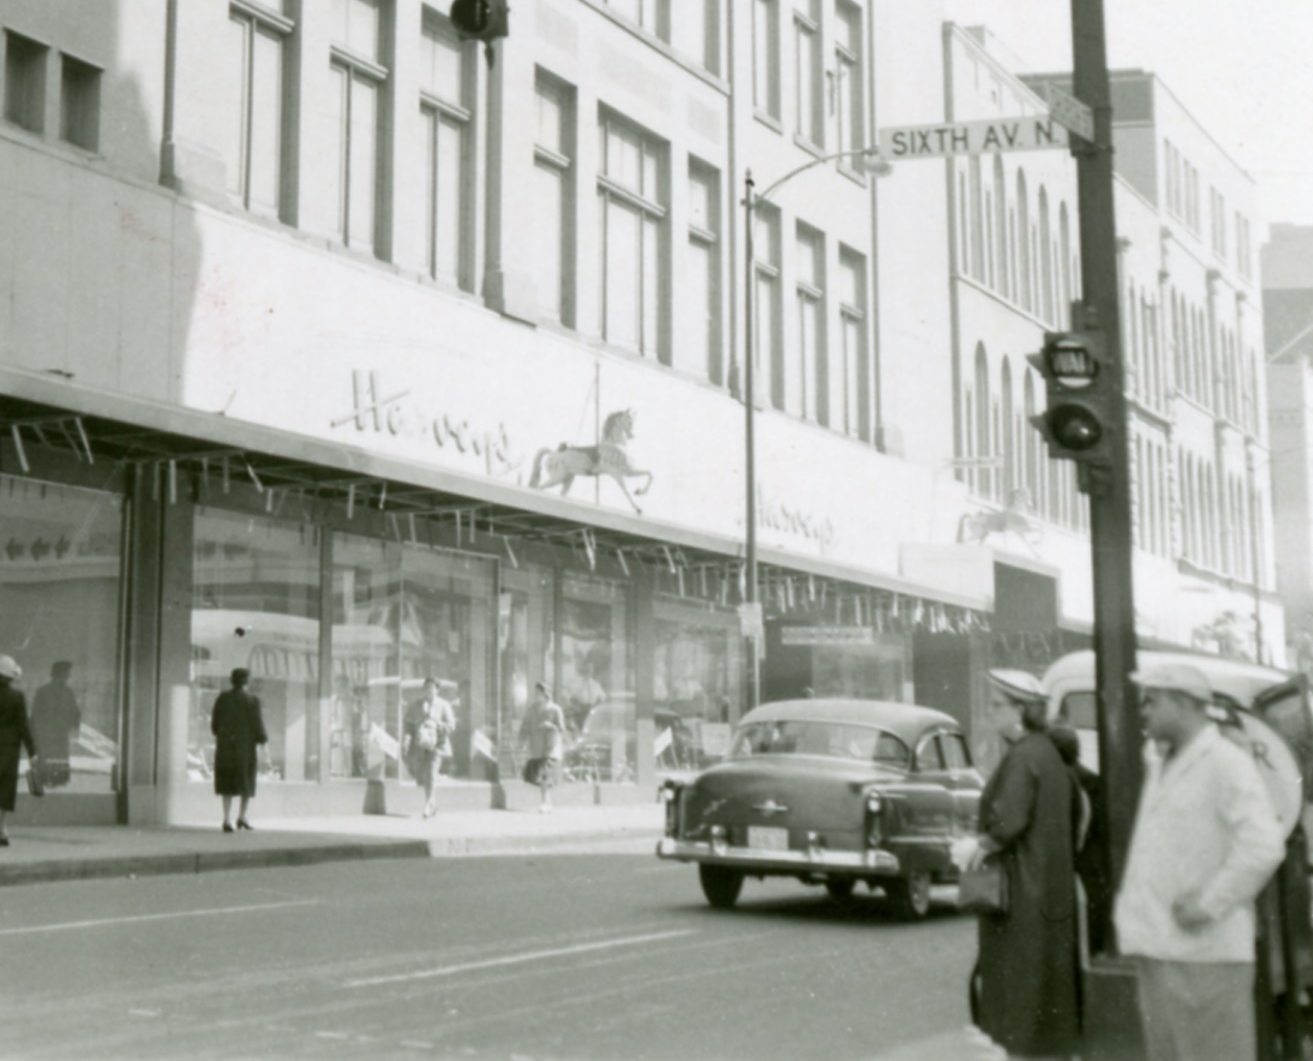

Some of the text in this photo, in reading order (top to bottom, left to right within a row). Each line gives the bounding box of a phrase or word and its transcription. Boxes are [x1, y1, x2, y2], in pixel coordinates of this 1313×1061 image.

[892, 126, 969, 155] SIXTH
[982, 121, 1022, 149] AV.
[330, 368, 526, 476] Haveys
